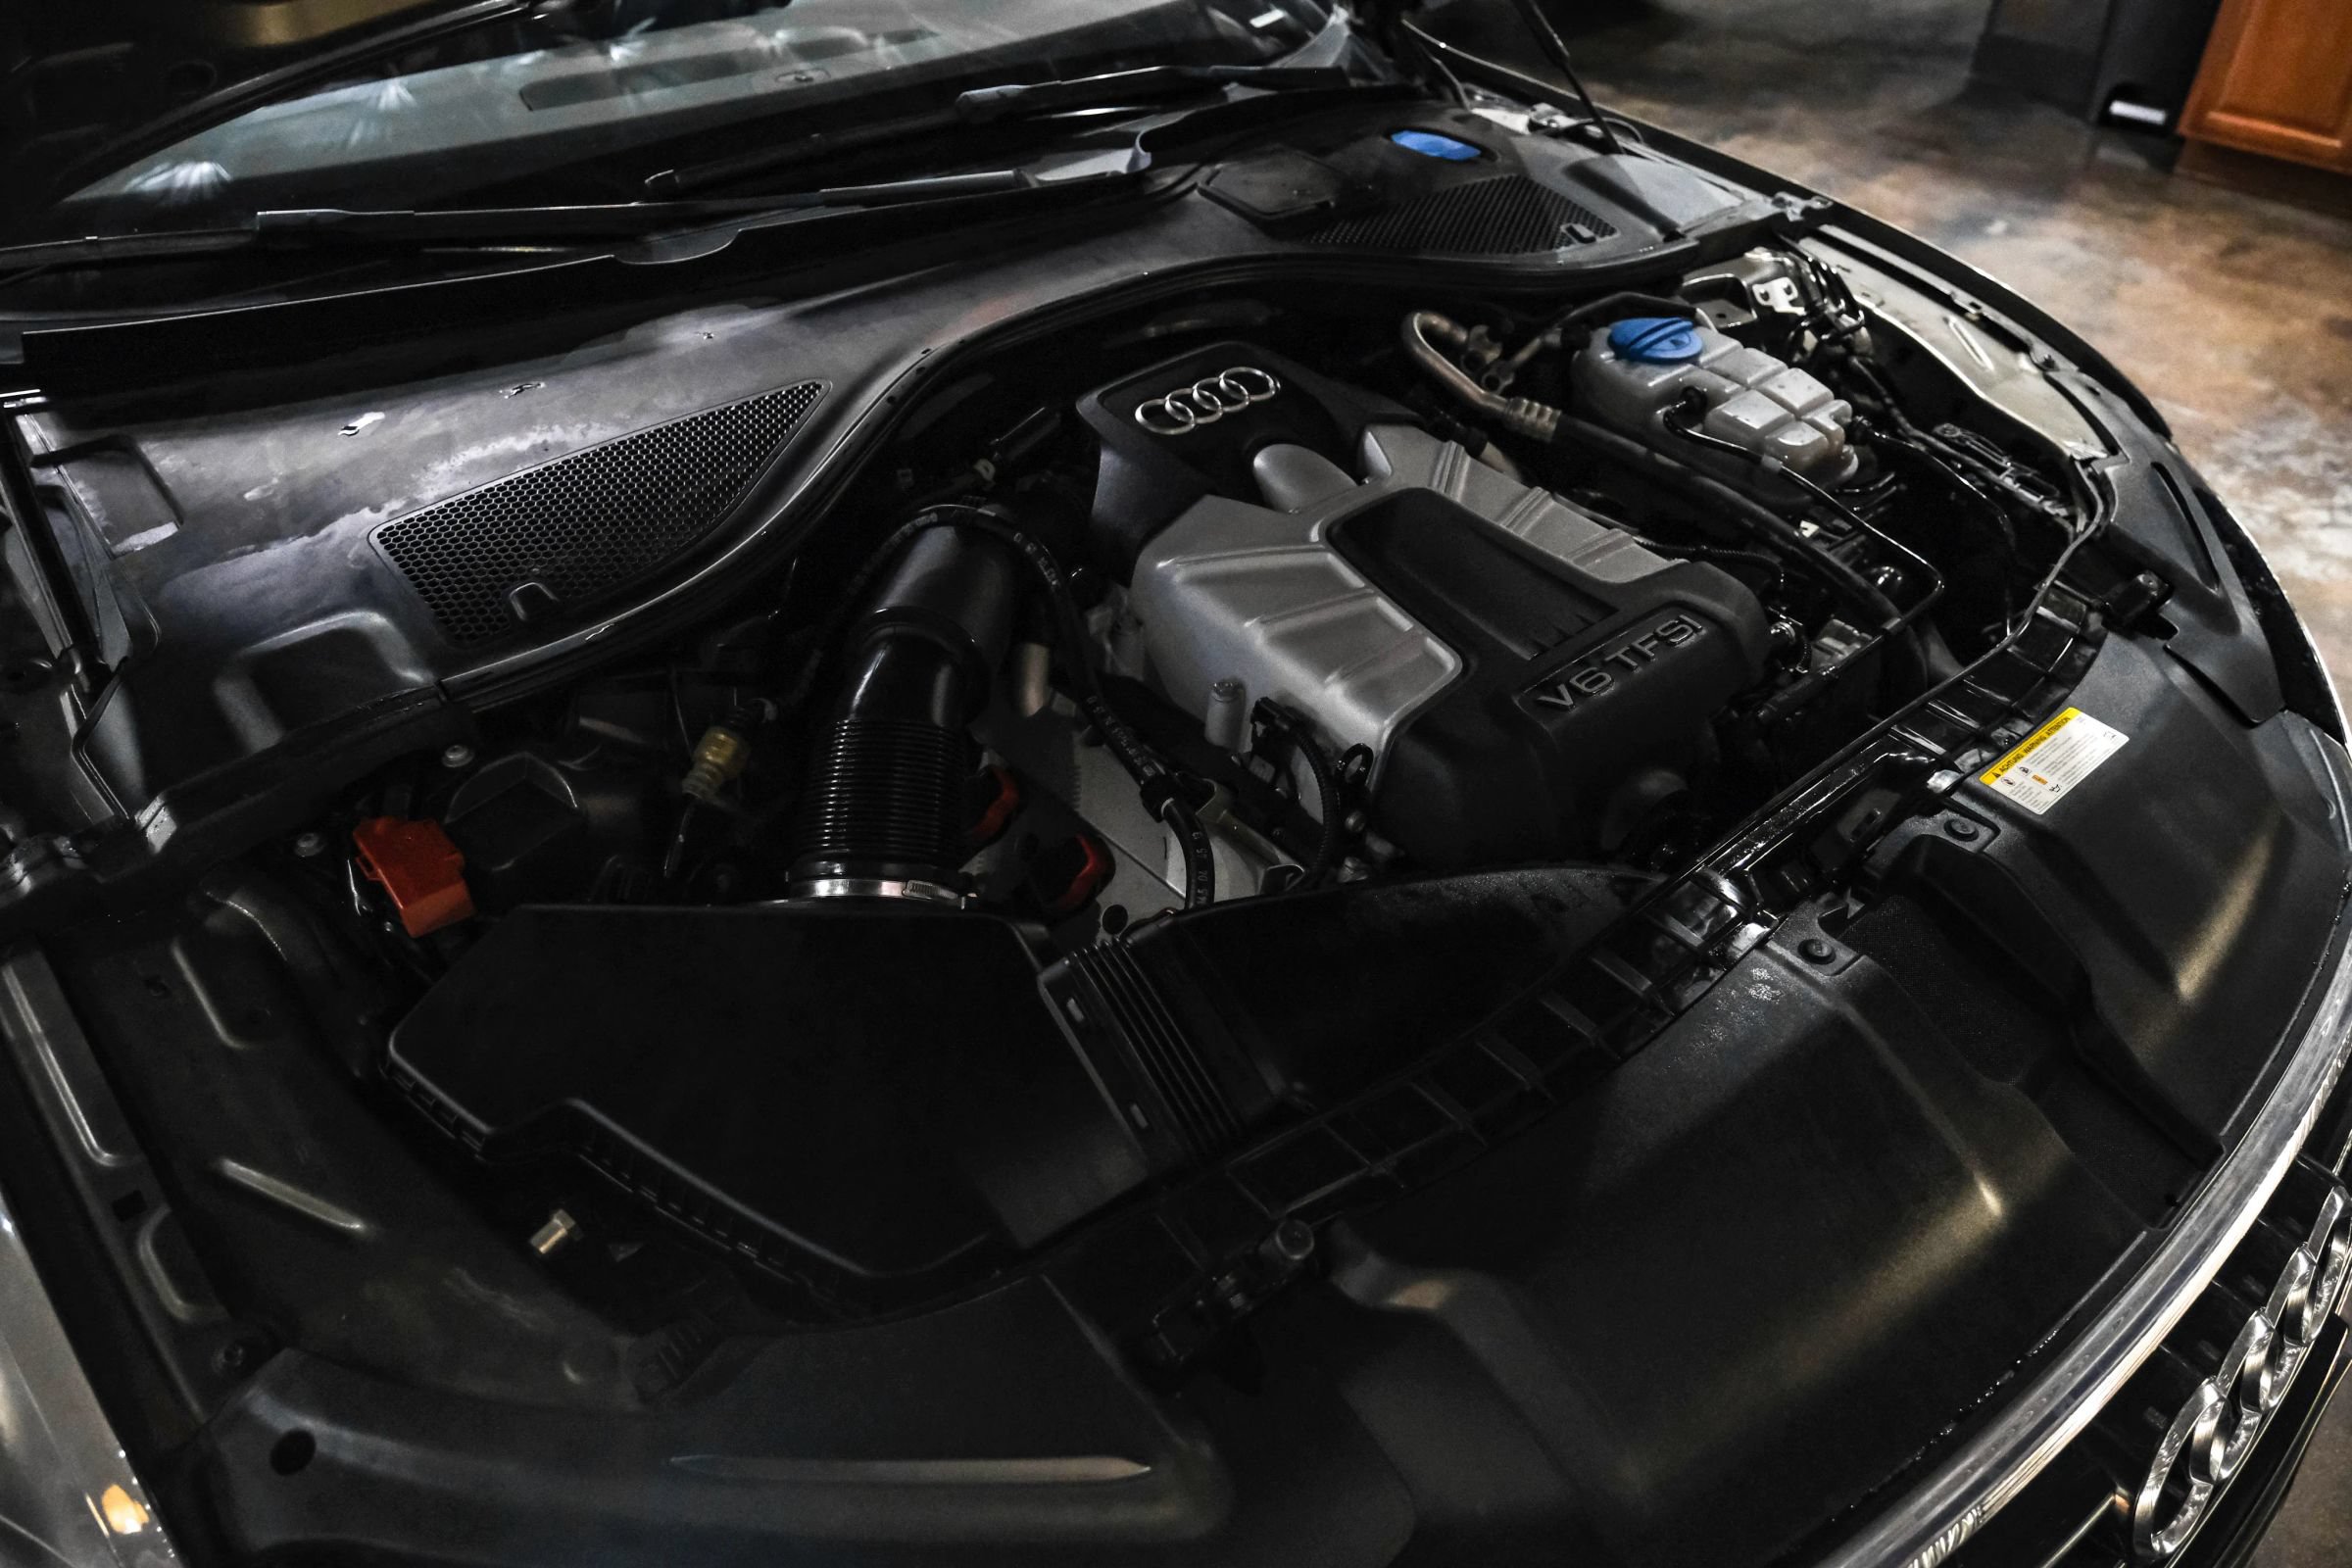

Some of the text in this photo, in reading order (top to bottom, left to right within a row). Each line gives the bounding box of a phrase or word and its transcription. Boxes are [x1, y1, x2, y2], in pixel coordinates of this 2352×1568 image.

[1536, 614, 1703, 710] V6 TFSI
[1999, 754, 2024, 773] ACHTUNG
[2023, 734, 2047, 754] WARNING
[2045, 716, 2070, 735] ATTENTION
